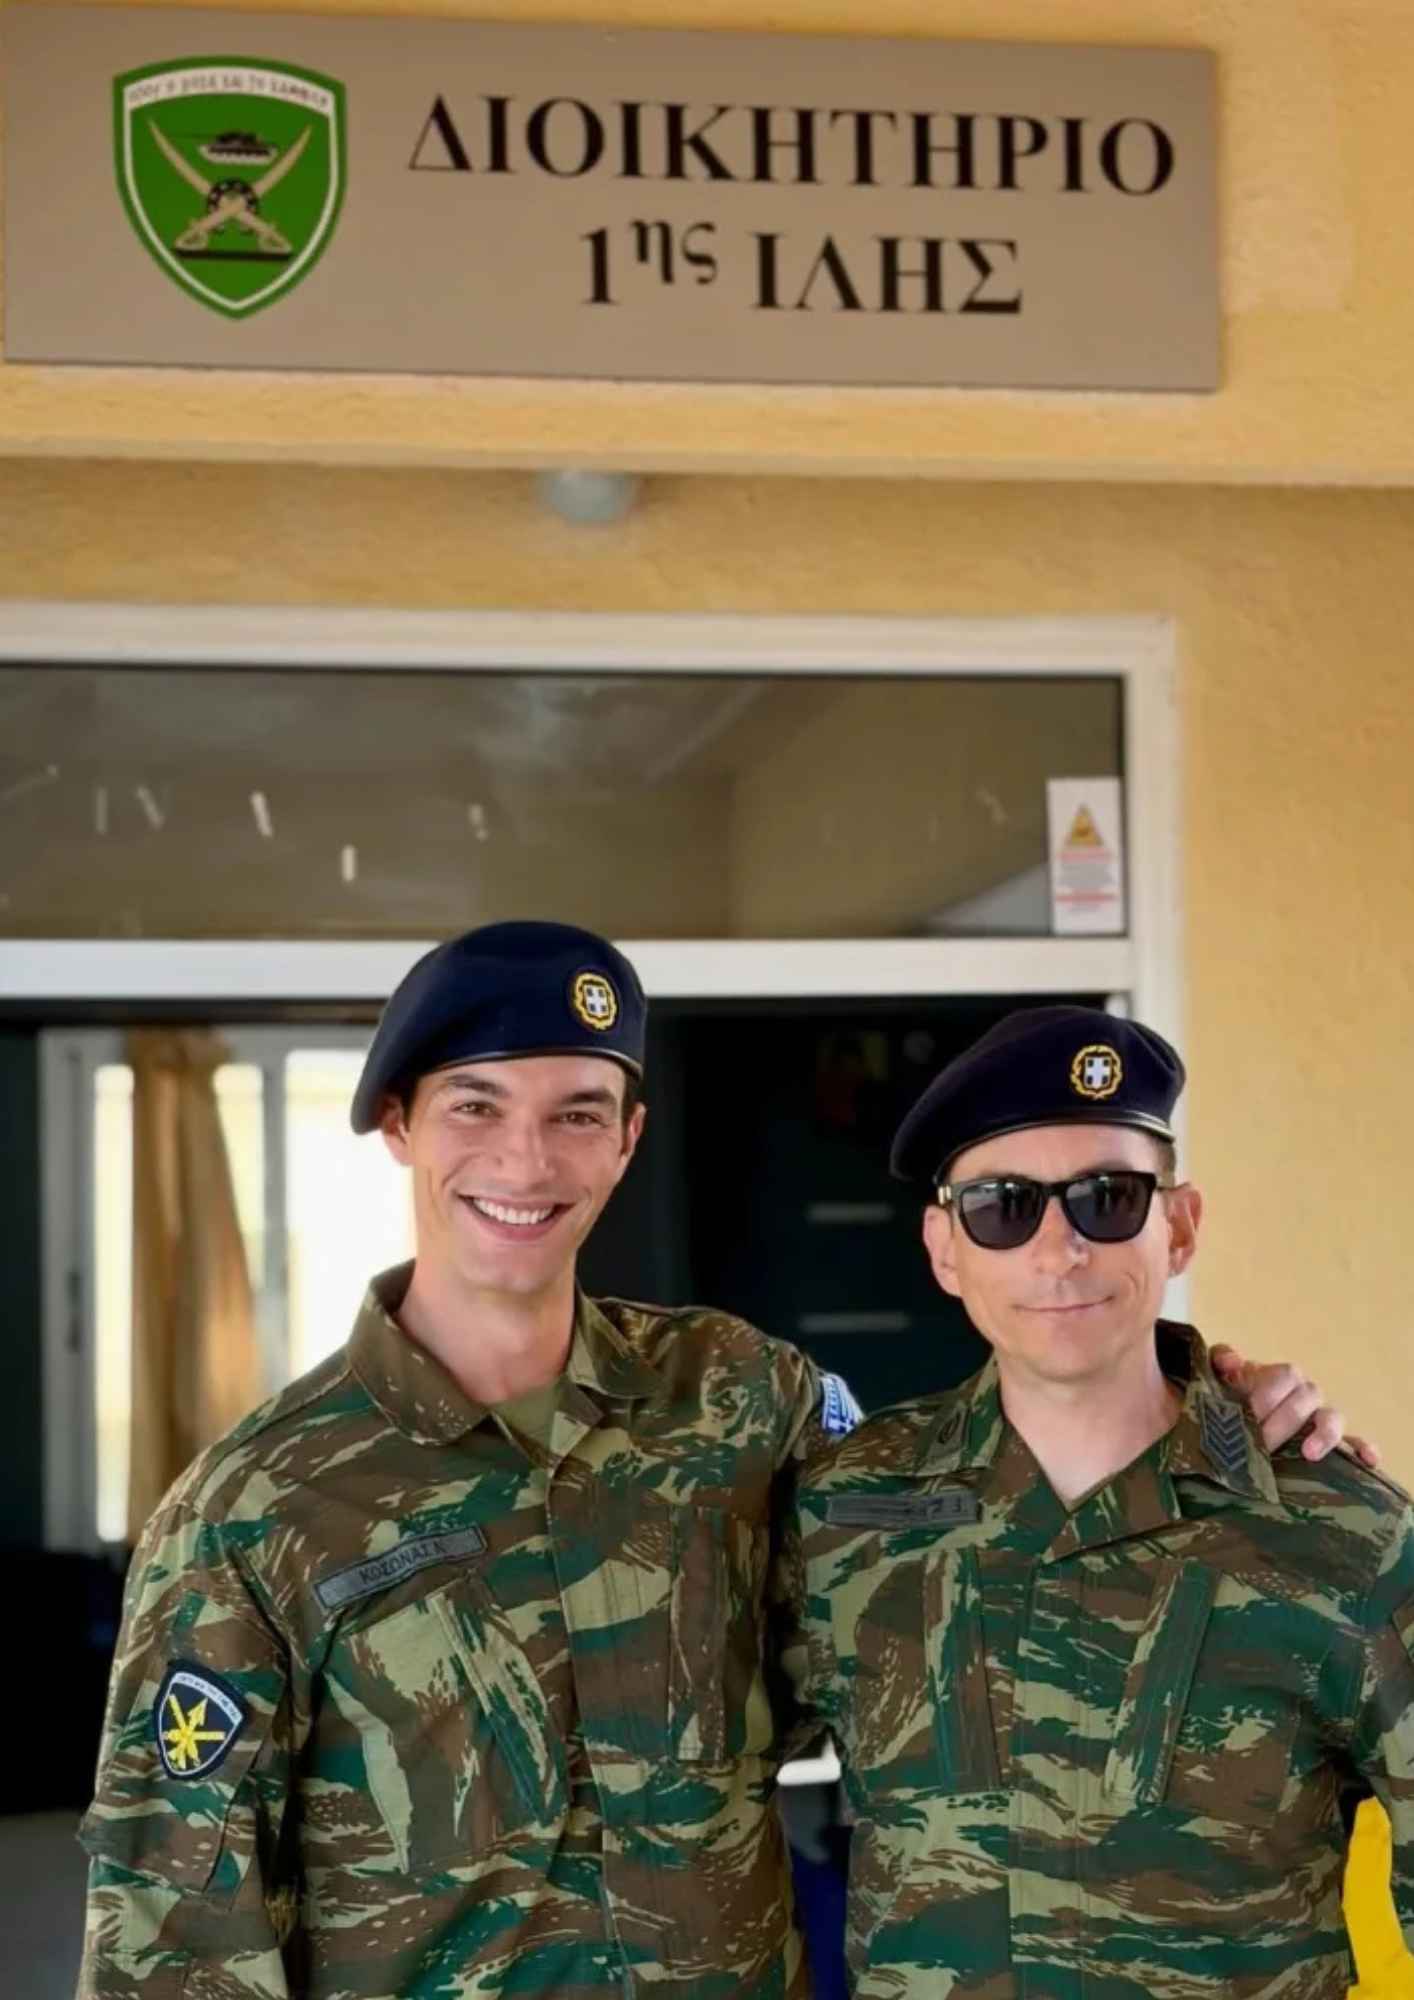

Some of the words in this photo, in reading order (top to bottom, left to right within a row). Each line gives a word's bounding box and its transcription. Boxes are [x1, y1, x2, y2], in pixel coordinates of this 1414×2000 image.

[408, 94, 1175, 196] ΔΙΟΙΚΗΤΗΡΙΟ
[580, 218, 719, 306] 1ης
[751, 232, 1023, 316] ΙΛΗΣ
